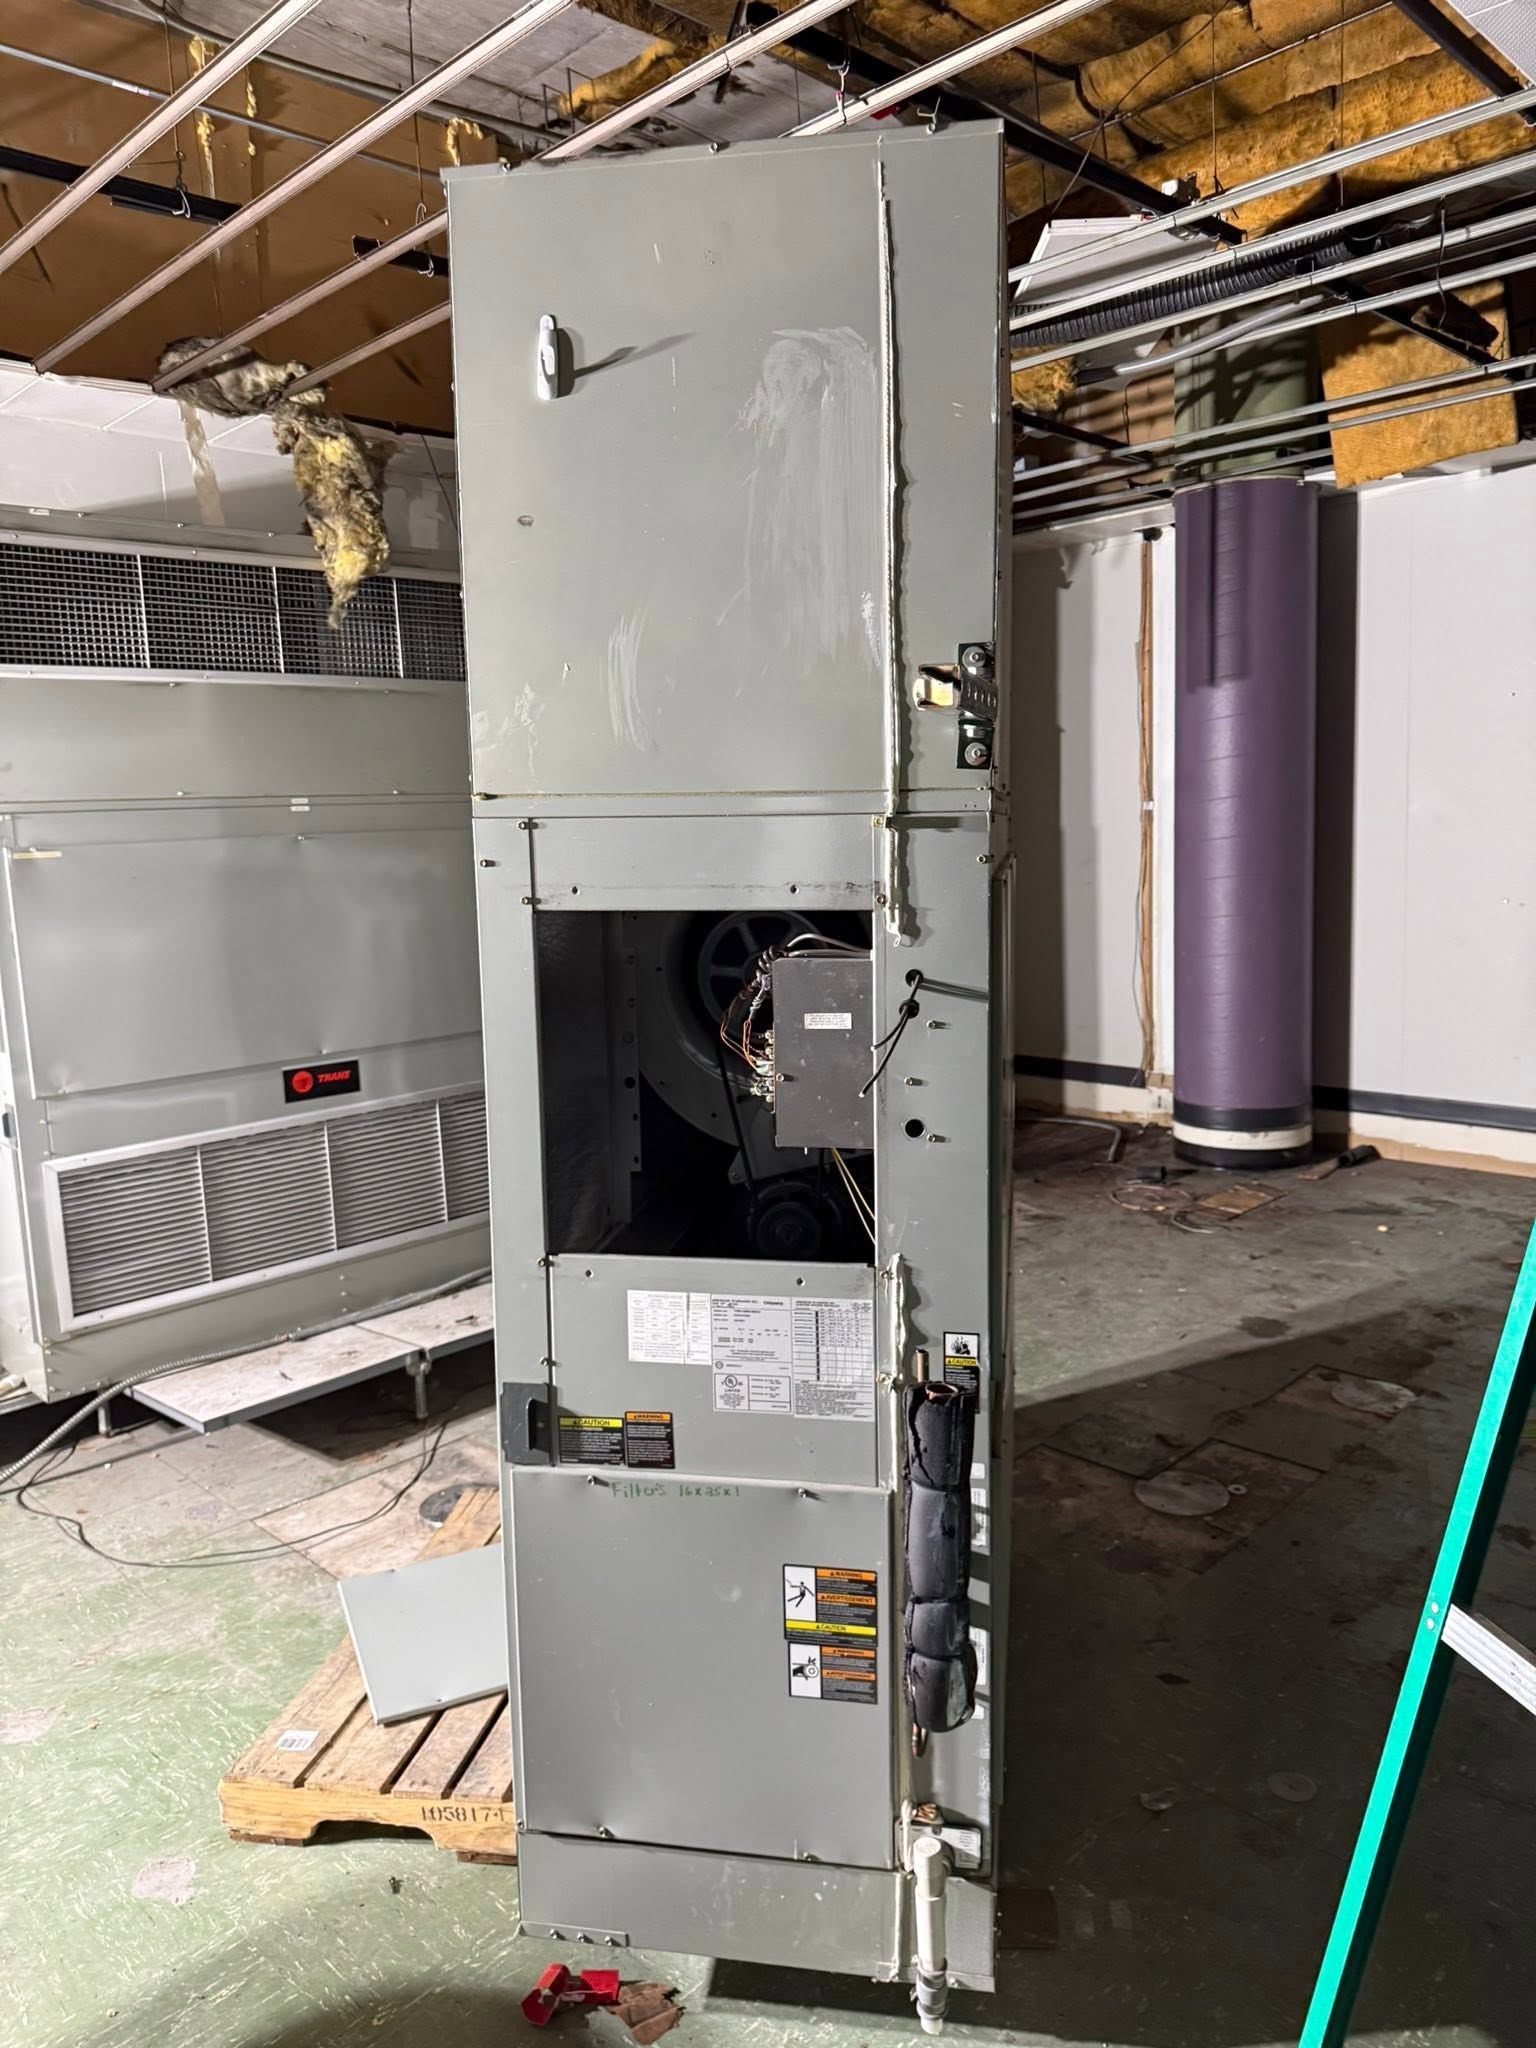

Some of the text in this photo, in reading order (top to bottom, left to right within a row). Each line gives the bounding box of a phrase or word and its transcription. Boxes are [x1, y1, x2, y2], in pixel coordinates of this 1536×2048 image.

[317, 1070, 351, 1083] TRANE
[577, 1418, 610, 1426] CAUTION
[820, 1624, 846, 1632] CAUTION
